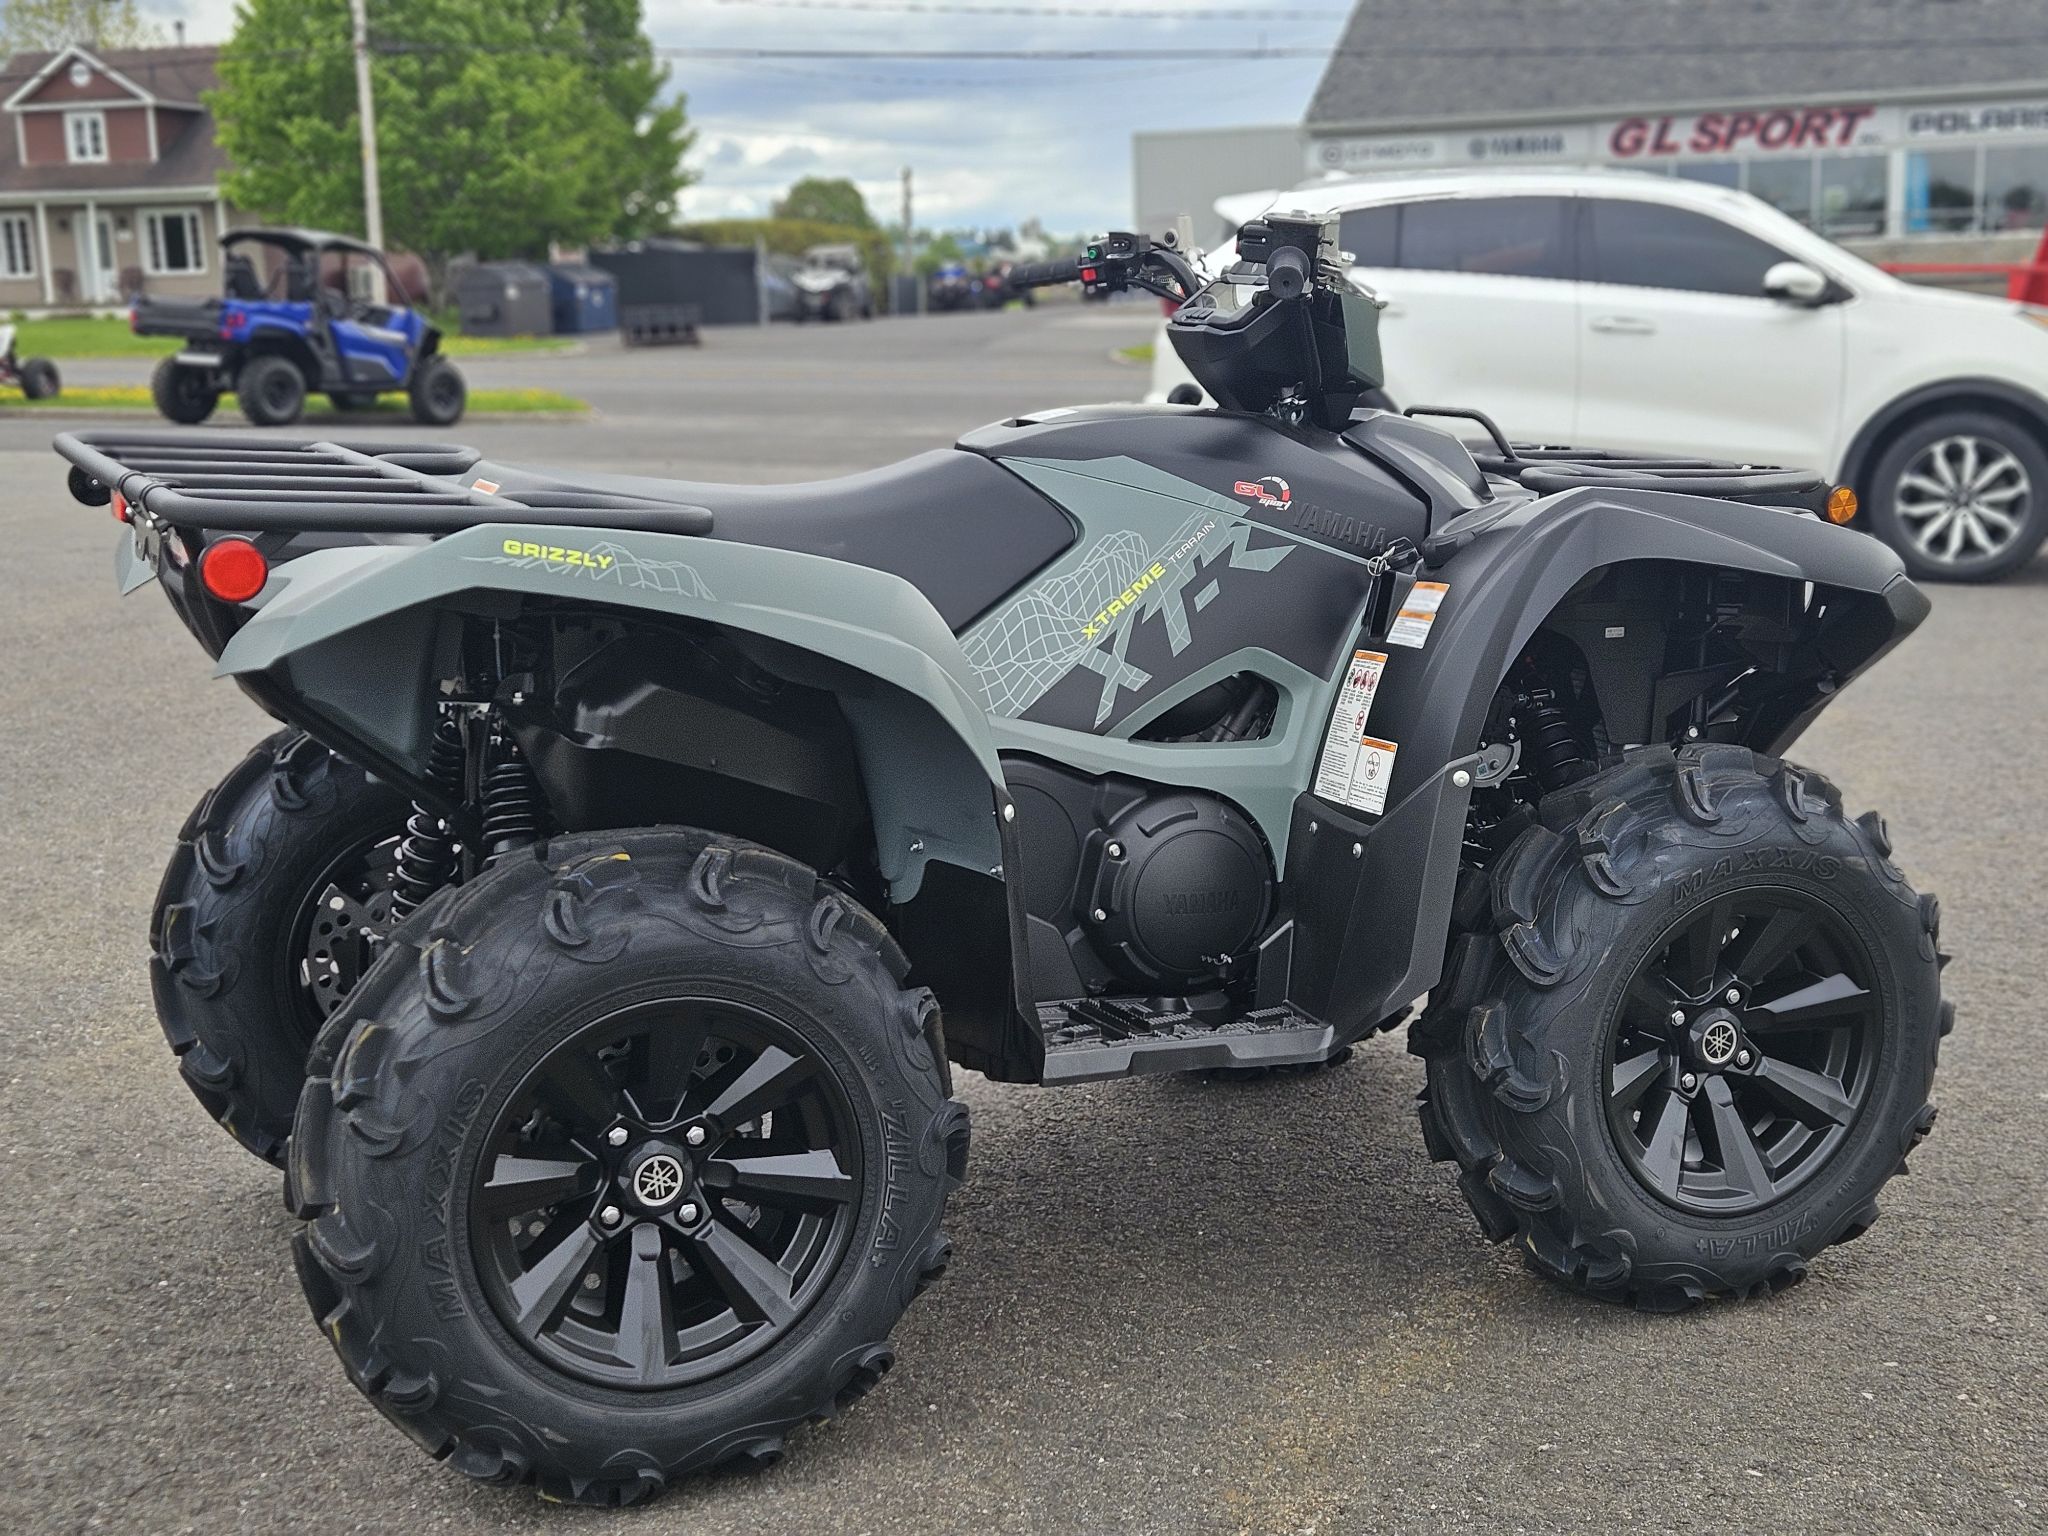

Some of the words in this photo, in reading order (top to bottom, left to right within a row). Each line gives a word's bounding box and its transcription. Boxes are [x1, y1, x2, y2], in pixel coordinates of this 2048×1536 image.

[1609, 116, 1679, 157] GL
[1689, 107, 1875, 153] SPORT
[1234, 480, 1277, 501] GL
[1168, 520, 1216, 564] TERRAIN
[1293, 502, 1386, 552] YAMAHA
[503, 540, 613, 569] GRIZZLY
[1671, 848, 1842, 904] MAXXIS
[423, 1077, 487, 1320] MAXXIS
